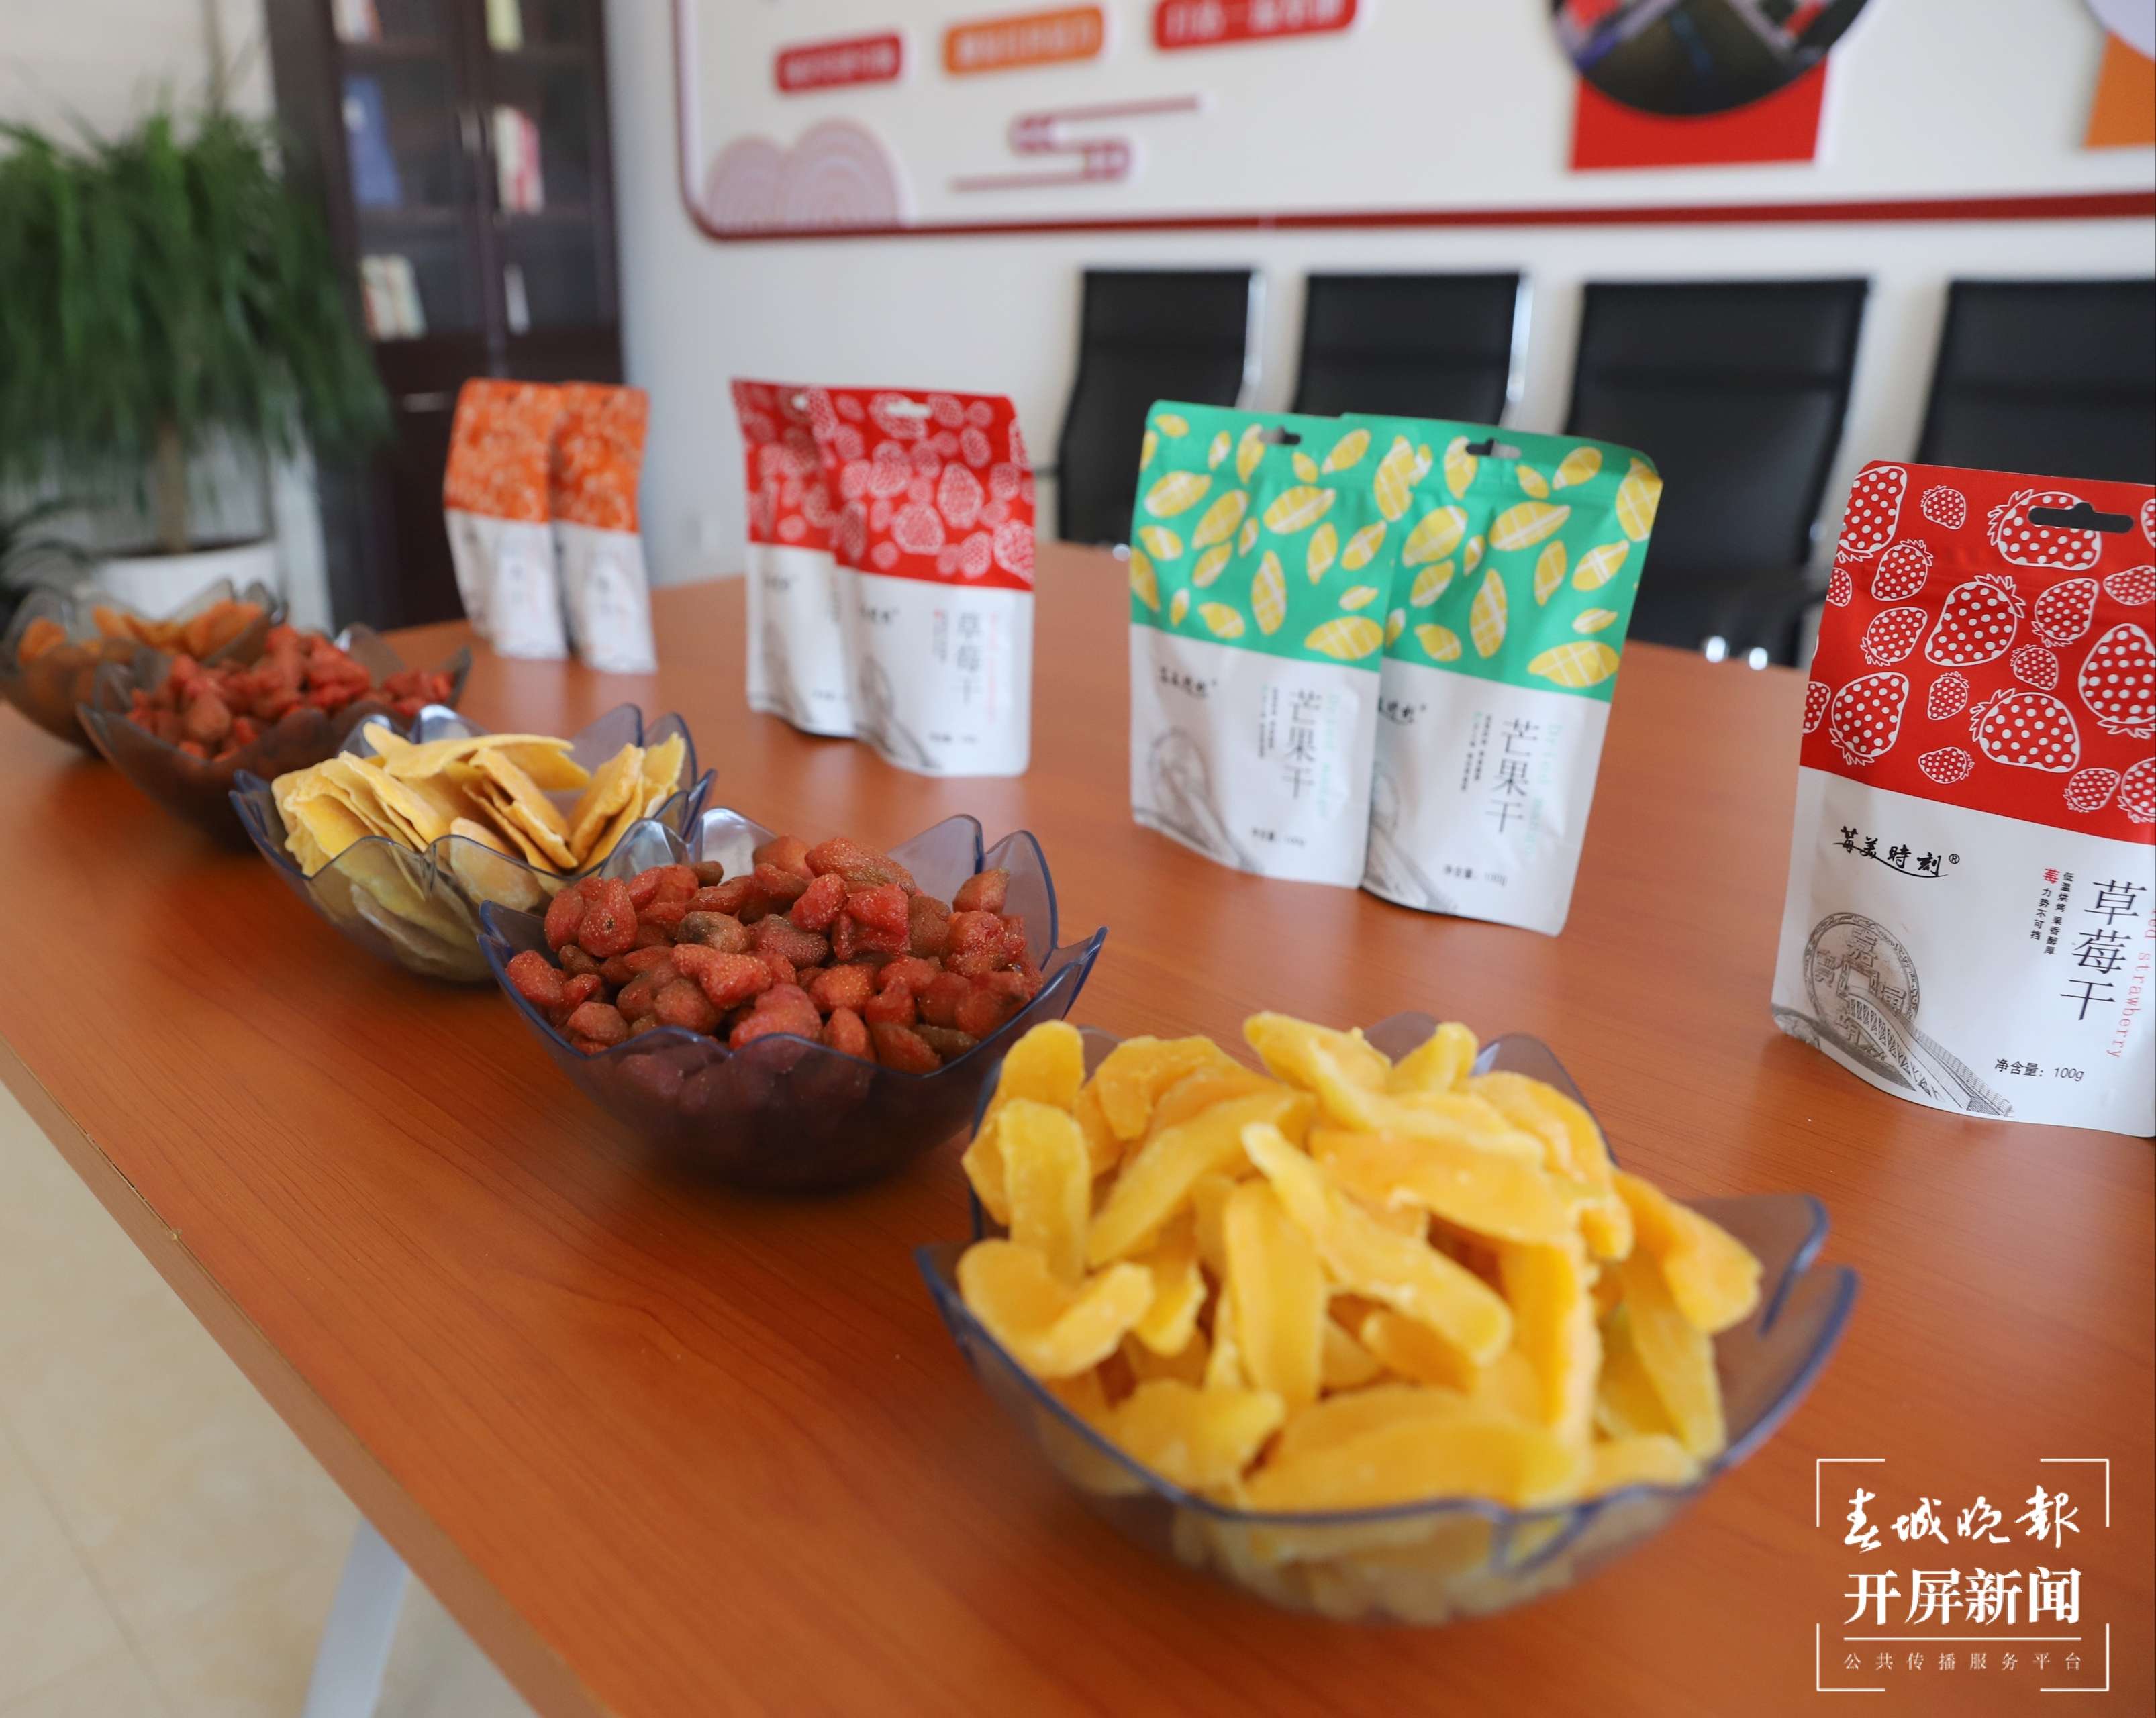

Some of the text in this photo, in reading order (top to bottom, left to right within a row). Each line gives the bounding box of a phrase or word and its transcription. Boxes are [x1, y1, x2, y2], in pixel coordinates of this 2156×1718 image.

[1281, 689, 1322, 799] 芒果干
[1485, 718, 1540, 834] 芒果干
[2060, 879, 2147, 1021] 草莓干
